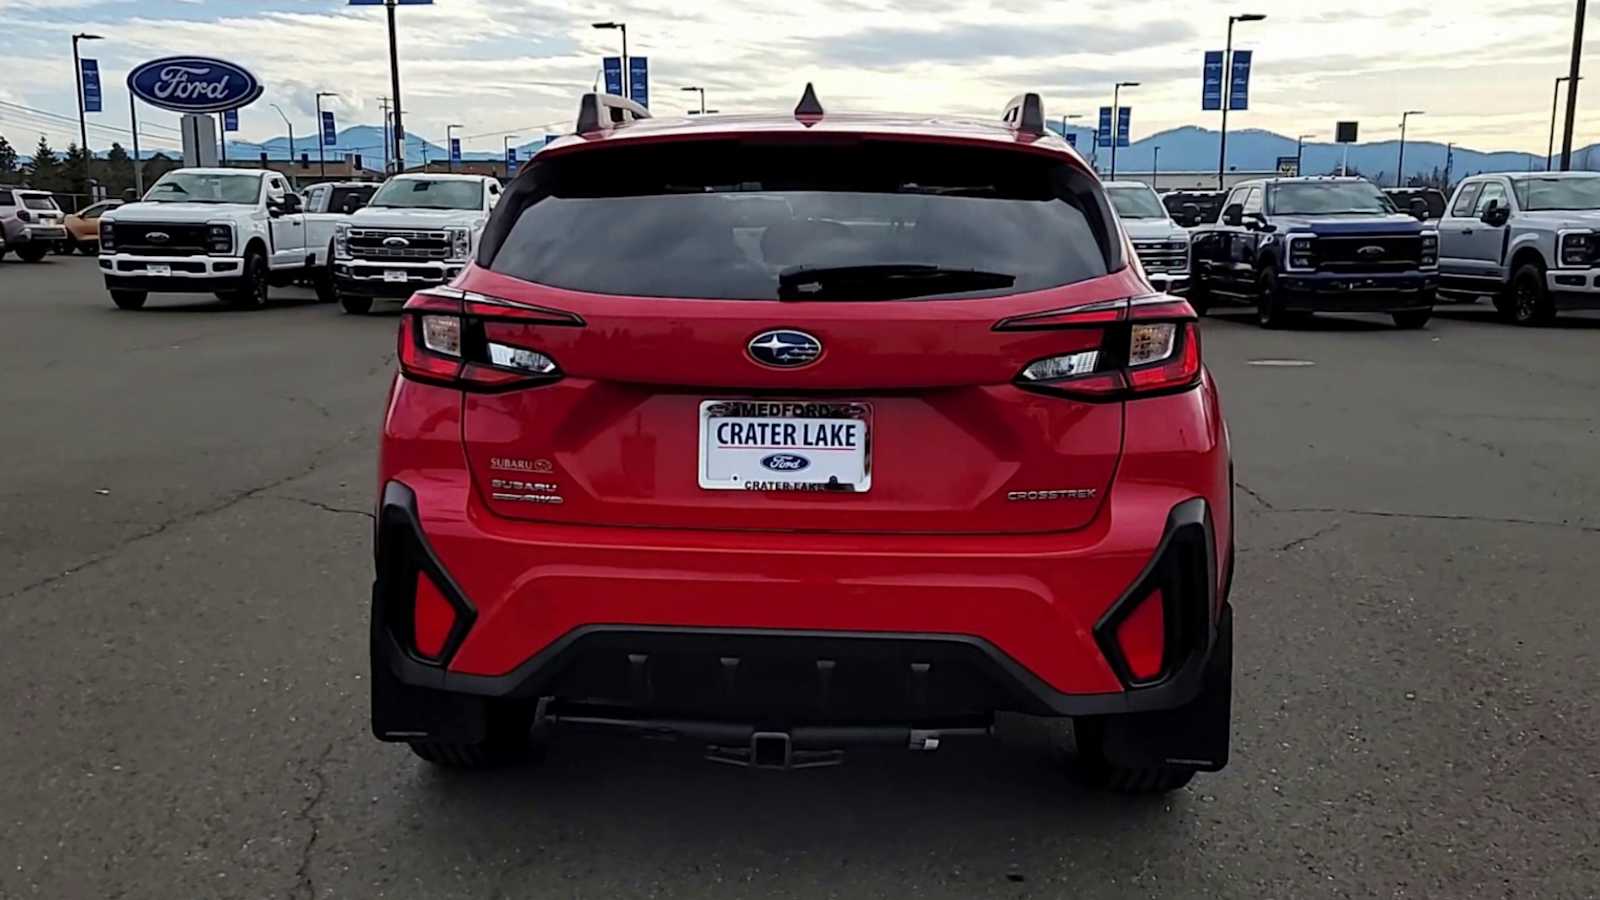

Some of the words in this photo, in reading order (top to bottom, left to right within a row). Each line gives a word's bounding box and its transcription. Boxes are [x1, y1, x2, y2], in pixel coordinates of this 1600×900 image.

[154, 66, 229, 98] Ford
[740, 402, 831, 417] MEDFORD
[717, 422, 796, 445] CRATER
[803, 423, 856, 446] LAKE
[490, 458, 533, 469] SUBARU
[769, 455, 801, 469] Ford
[491, 479, 557, 491] SUBARU
[744, 480, 788, 492] CRATER
[1007, 488, 1096, 500] CROSSTREK
